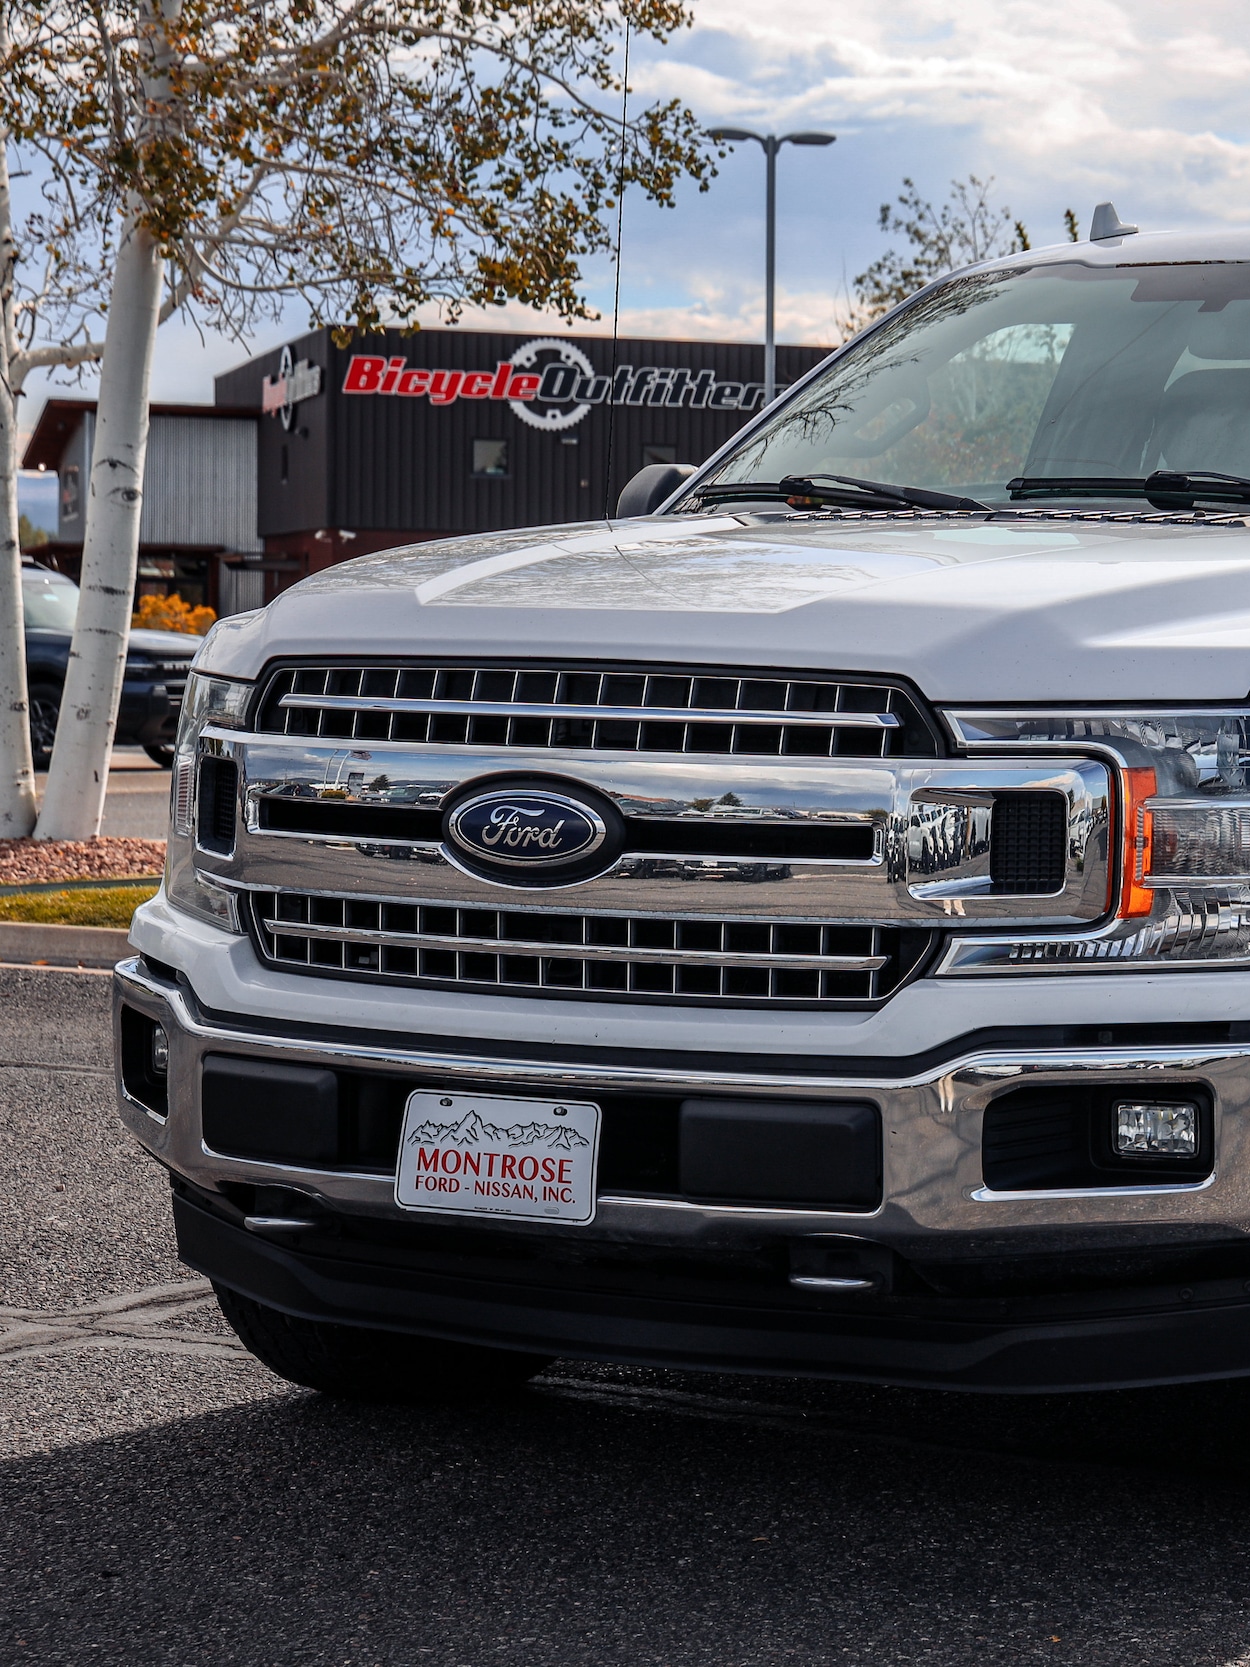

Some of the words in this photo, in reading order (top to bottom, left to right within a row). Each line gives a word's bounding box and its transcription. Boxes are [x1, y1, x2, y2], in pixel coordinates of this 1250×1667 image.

[481, 805, 565, 848] Ford
[417, 1147, 573, 1184] MONTROSE
[415, 1175, 460, 1193] FORD
[474, 1180, 538, 1203] NISSAN,
[543, 1186, 576, 1204] INC.
